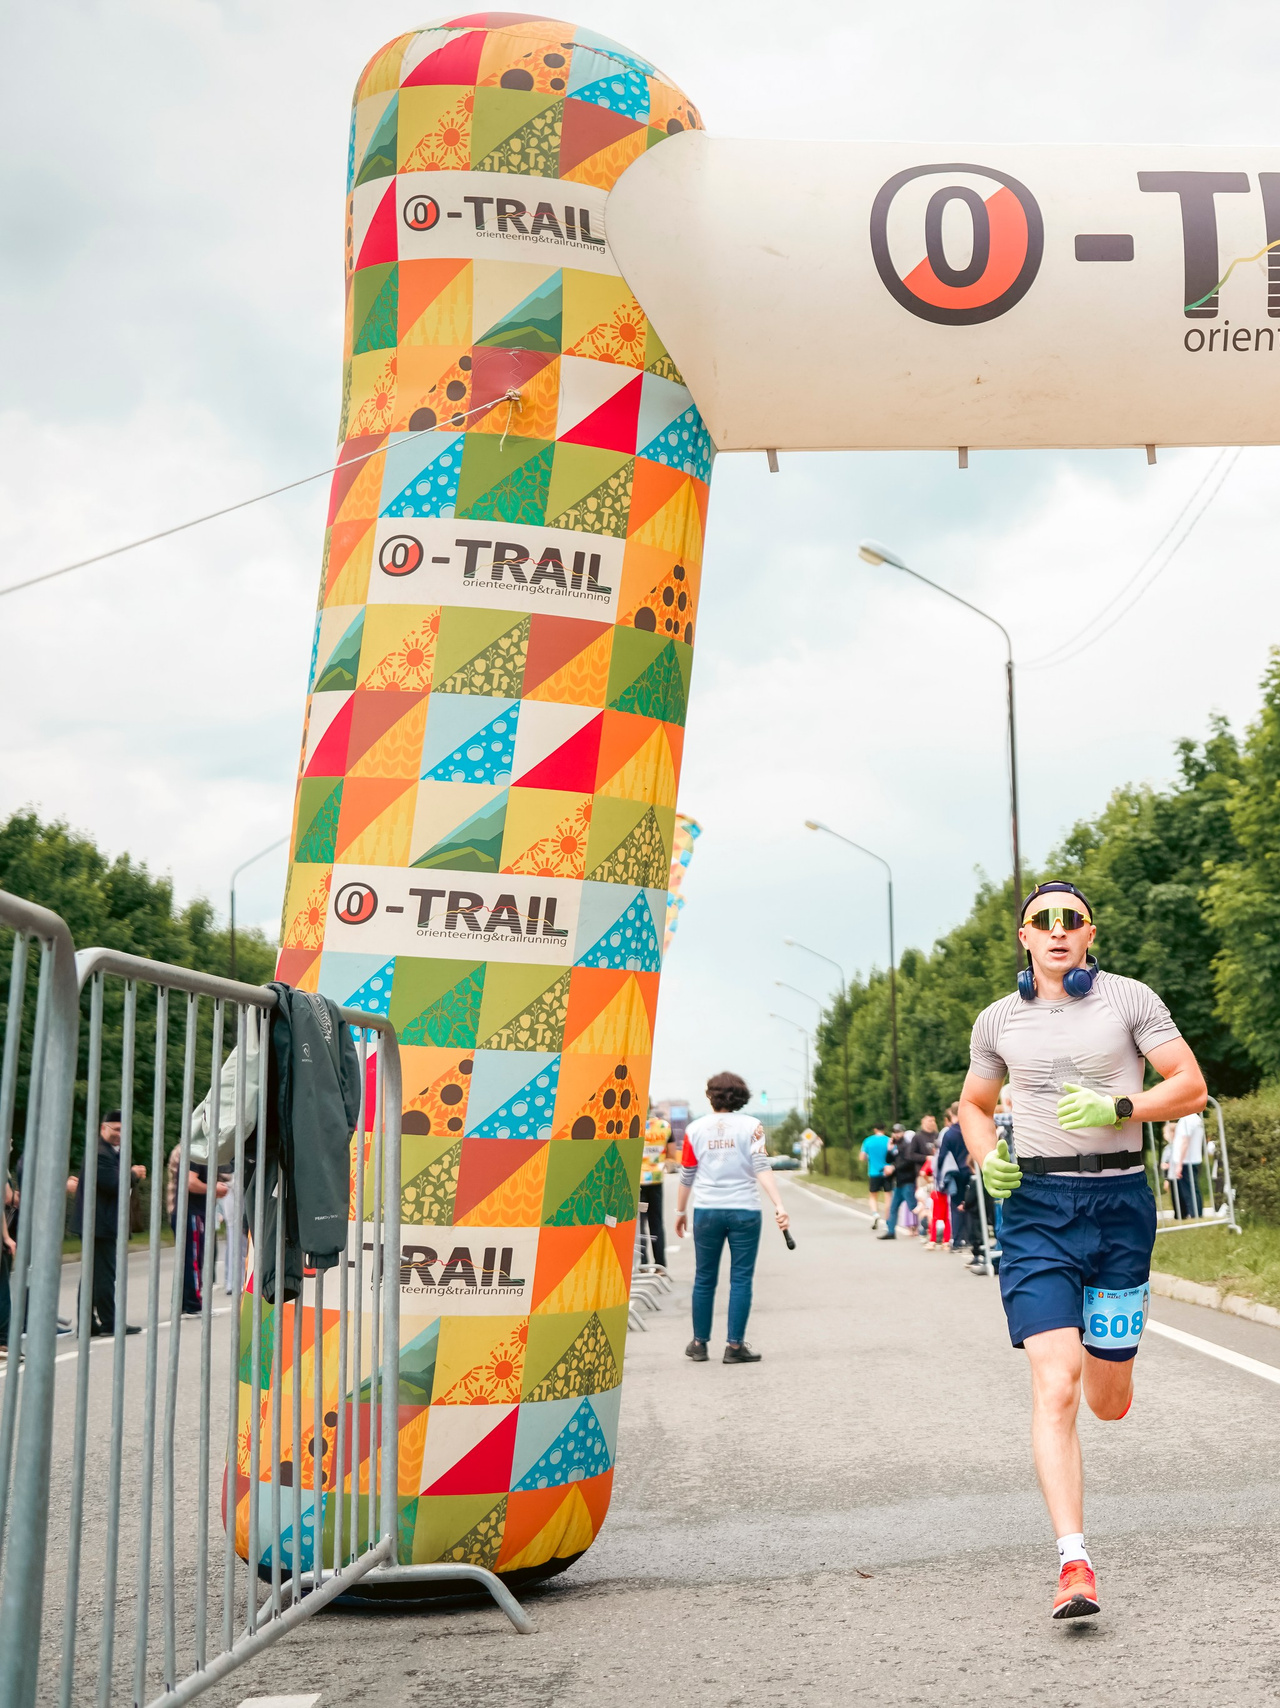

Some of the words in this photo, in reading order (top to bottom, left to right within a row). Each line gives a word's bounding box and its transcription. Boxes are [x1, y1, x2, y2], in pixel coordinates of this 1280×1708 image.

[476, 229, 606, 254] orienteering&trailrunning
[462, 578, 612, 604] orienteering&trailrunning
[416, 928, 568, 947] orienteering&trailrunning
[708, 1138, 736, 1150] ЕЛЕНА
[1089, 1310, 1144, 1338] 608
